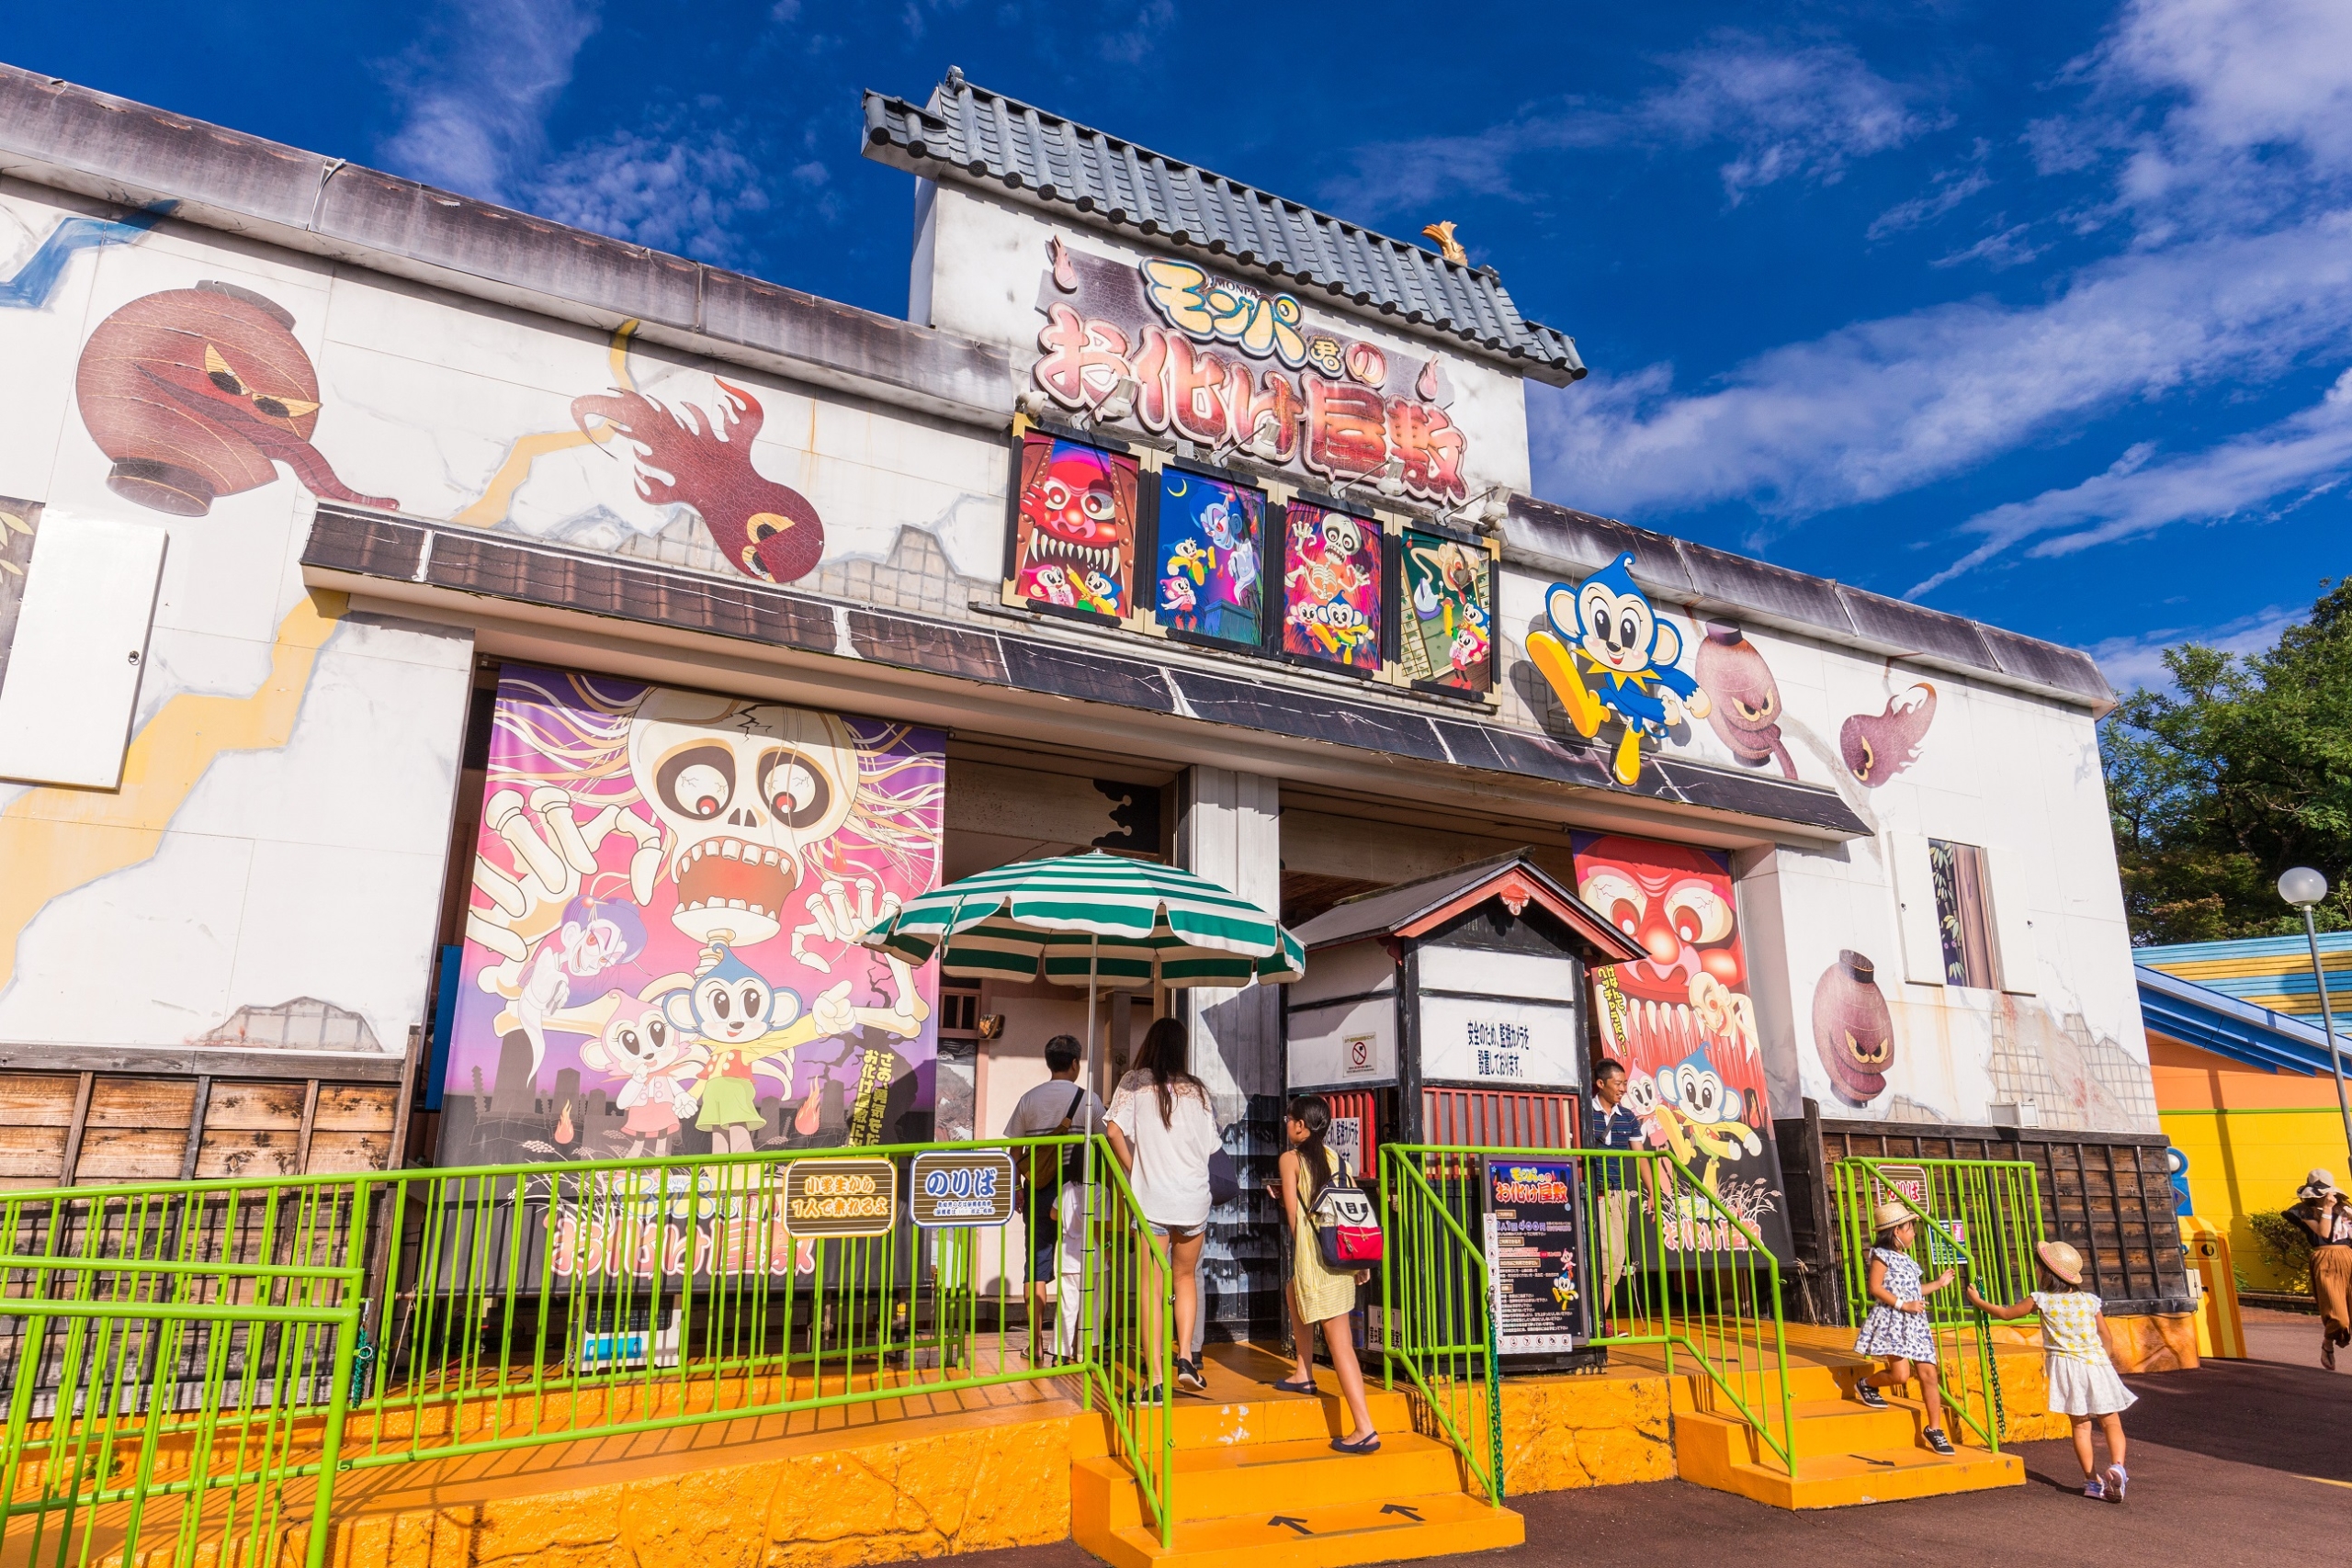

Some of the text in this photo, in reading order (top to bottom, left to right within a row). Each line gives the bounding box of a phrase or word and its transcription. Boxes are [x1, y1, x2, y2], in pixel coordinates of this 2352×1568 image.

[1213, 277, 1260, 297] MONPA
[1139, 256, 1387, 389] モンパ君の
[1035, 301, 1468, 505] お化け屋敷
[1467, 1019, 1530, 1050] 安全のため、監視カメラを
[1477, 1049, 1523, 1077] 設置しております。
[804, 1175, 876, 1195] 小学生から
[925, 1168, 997, 1198] のりば
[1496, 1180, 1568, 1203] お化け屋敷
[791, 1197, 888, 1218] 1人で乗れるよ
[550, 1215, 817, 1280] お化け屋敷
